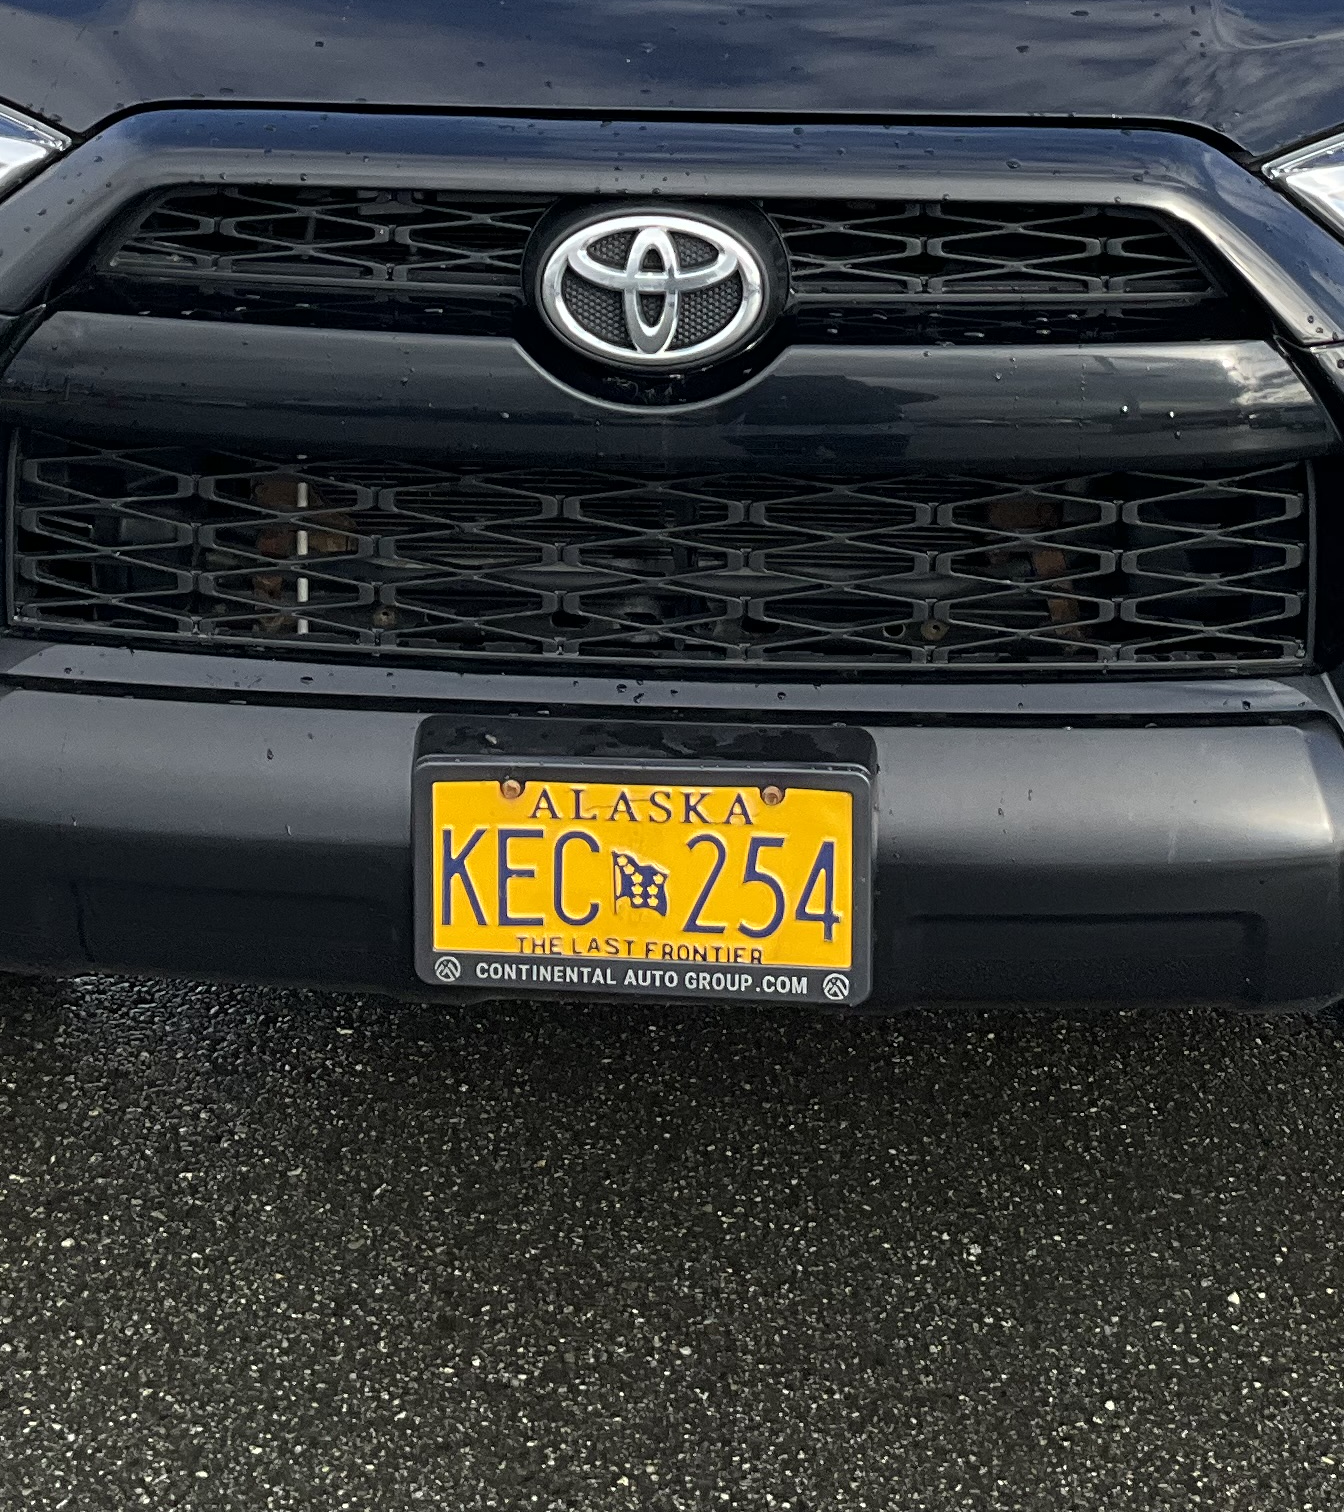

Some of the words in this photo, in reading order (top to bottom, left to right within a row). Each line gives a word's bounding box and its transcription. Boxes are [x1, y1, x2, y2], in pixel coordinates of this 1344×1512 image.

[529, 790, 754, 825] ALASKA
[441, 828, 601, 926] KEC
[682, 833, 841, 942] 254
[516, 937, 562, 955] THE
[572, 938, 636, 957] LAST
[645, 942, 763, 965] FRONTIER
[475, 962, 617, 985] CONTINENTAL
[623, 969, 678, 989] AUTO
